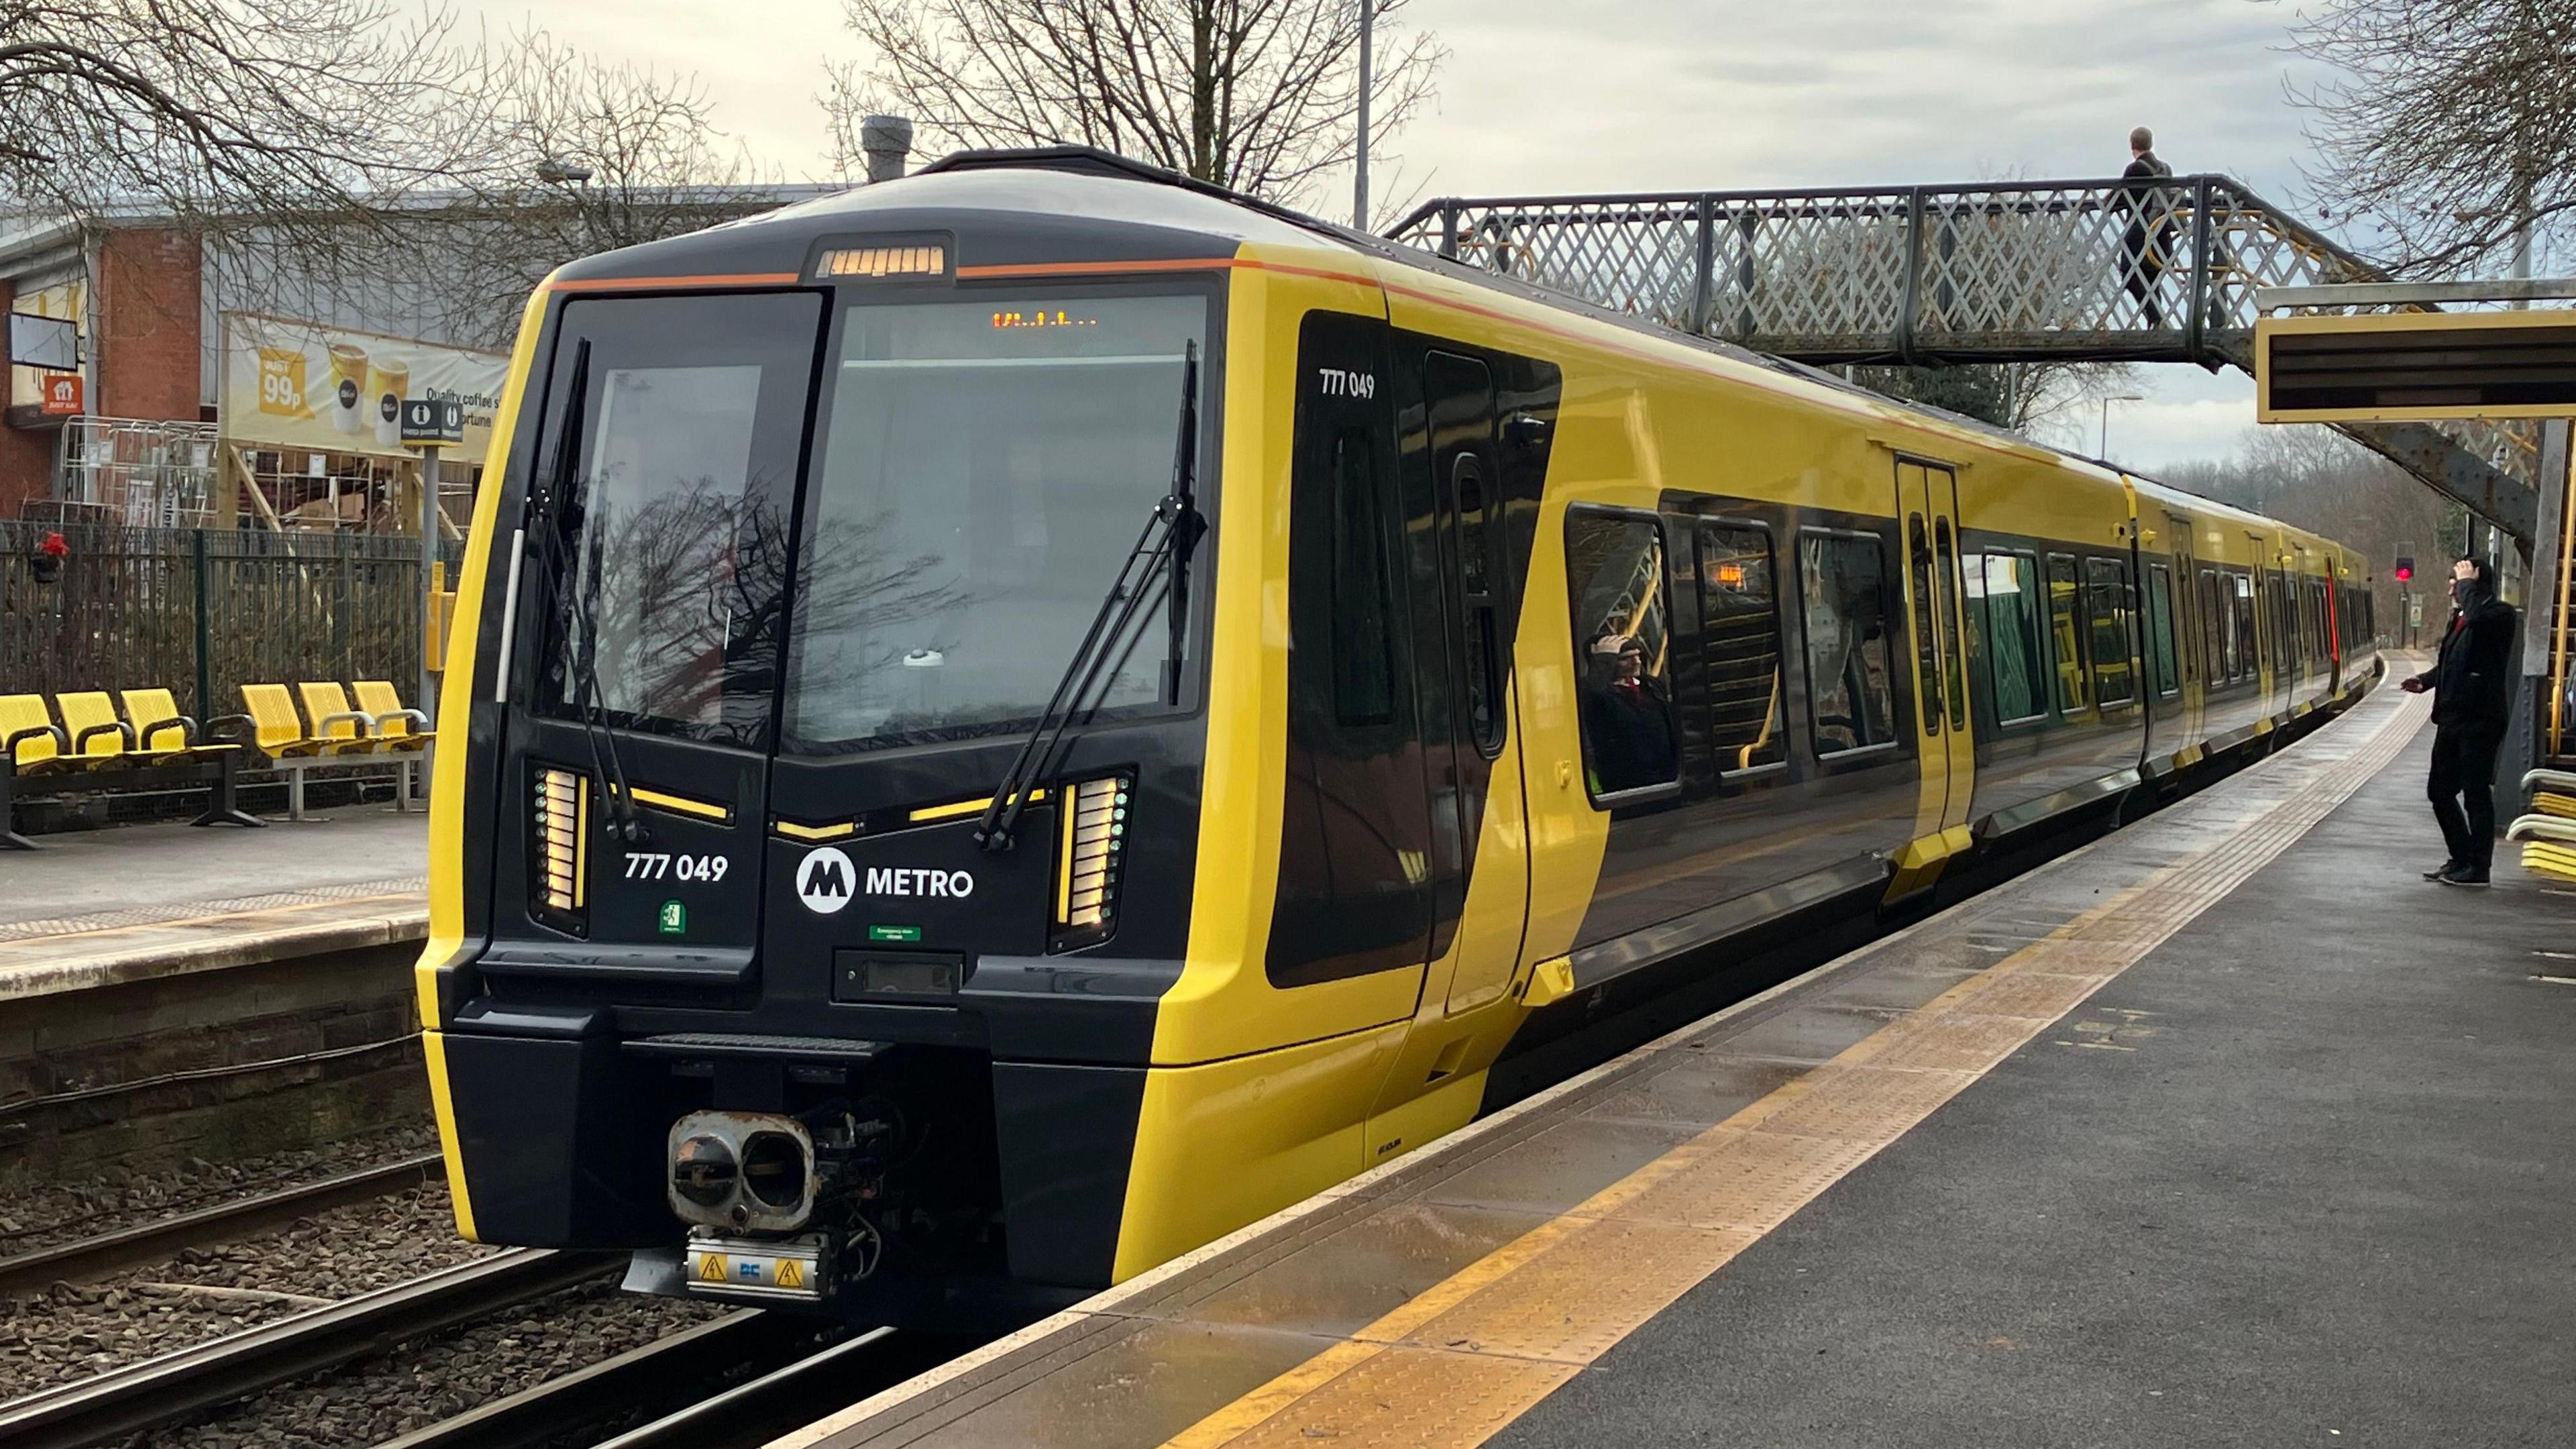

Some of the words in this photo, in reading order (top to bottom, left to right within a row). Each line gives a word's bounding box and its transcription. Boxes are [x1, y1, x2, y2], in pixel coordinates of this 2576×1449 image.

[264, 360, 289, 372] JUST
[264, 373, 301, 411] 99p
[427, 387, 462, 404] Quality
[1319, 368, 1346, 396] 777
[1349, 372, 1375, 399] 049
[462, 412, 491, 427] ortune
[625, 852, 671, 879] 777
[676, 854, 729, 881] 049
[865, 867, 973, 898] METRO
